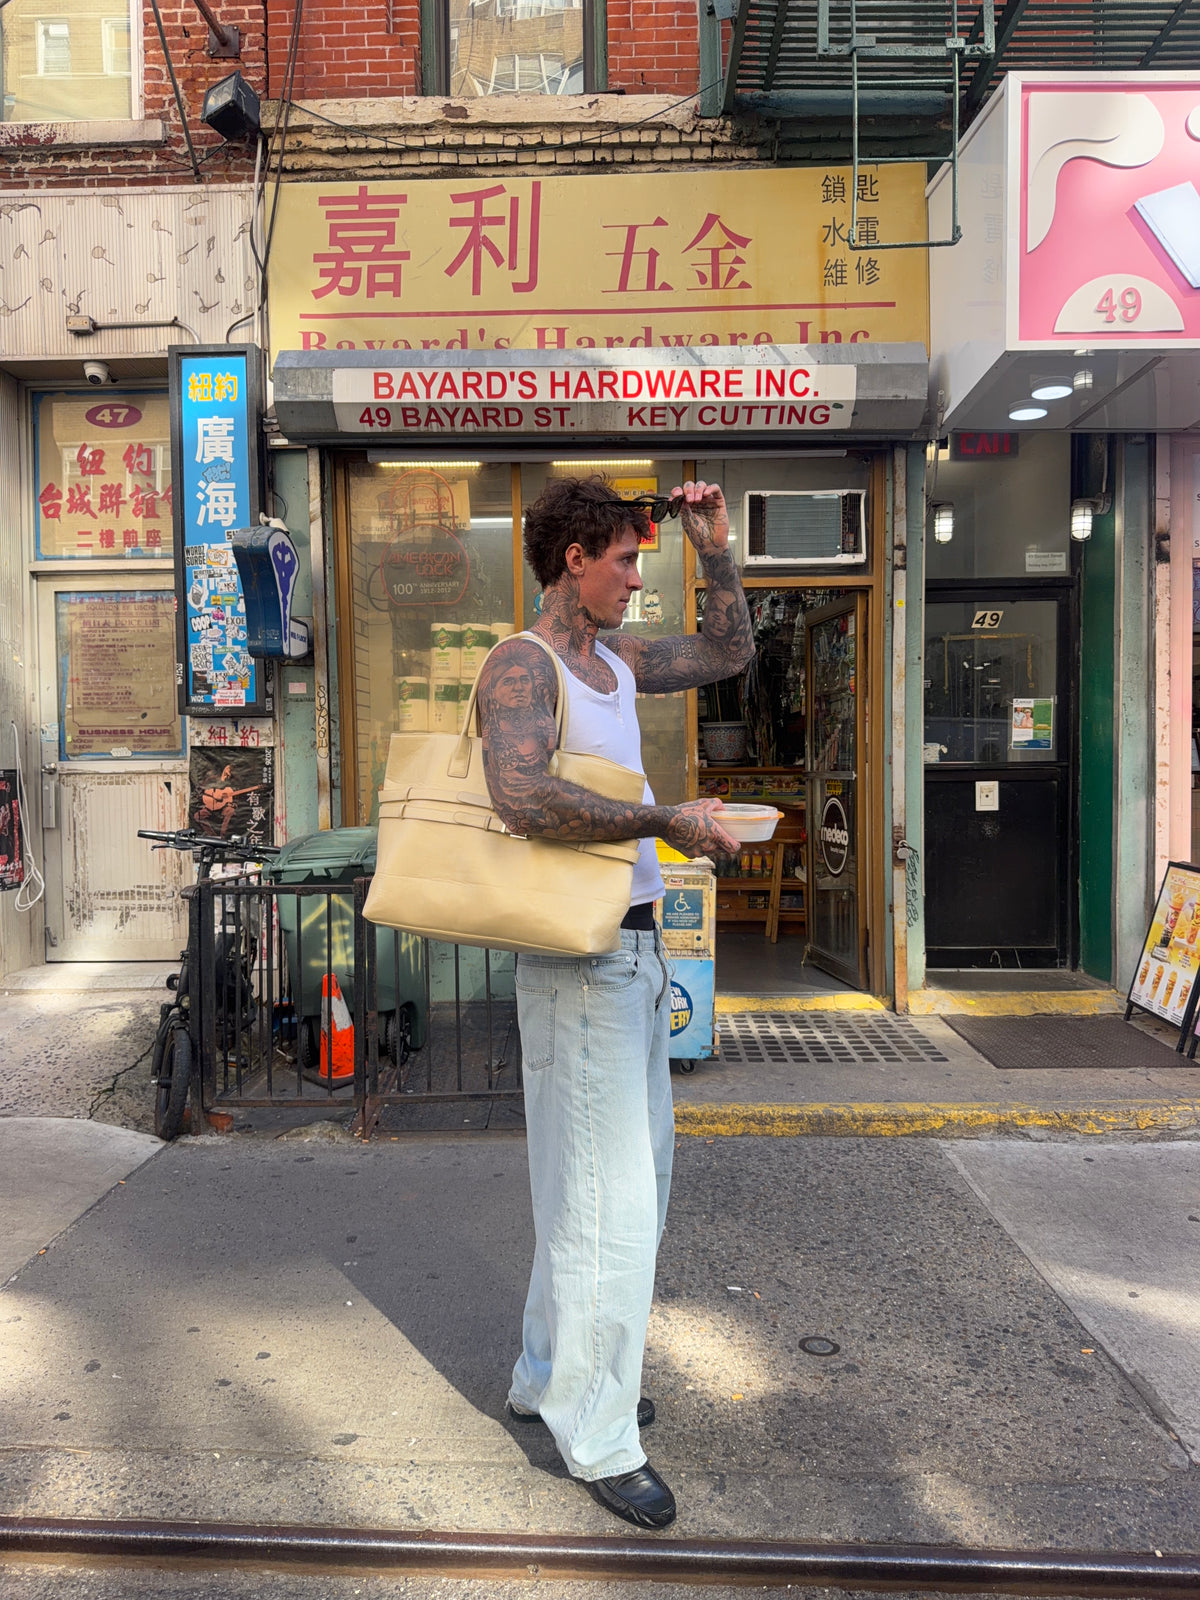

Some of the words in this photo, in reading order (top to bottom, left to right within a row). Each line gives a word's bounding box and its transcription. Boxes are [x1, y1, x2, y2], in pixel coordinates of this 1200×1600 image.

[821, 174, 879, 204] 鎖匙
[311, 181, 541, 299] 嘉利
[602, 213, 753, 292] 五金
[822, 217, 880, 247] 水電
[823, 256, 880, 287] 維修
[1096, 287, 1142, 322] 49
[188, 372, 238, 402] 紐約
[373, 371, 537, 400] BAYARD'S
[550, 369, 744, 399] HARDWARE
[755, 368, 820, 398] INC.
[95, 408, 129, 424] 47
[359, 407, 392, 428] 49
[402, 406, 523, 428] BAYARD
[534, 406, 576, 428] ST.
[627, 405, 689, 427] KEY
[697, 403, 831, 426] CUTTING
[76, 442, 152, 477] 紐約
[388, 551, 461, 564] AMERICAN
[415, 564, 454, 576] LOCK
[974, 612, 1001, 628] 49
[207, 725, 260, 747] 紐約
[820, 822, 849, 846] medeco
[670, 986, 682, 997] EW
[670, 996, 689, 1011] ORK
